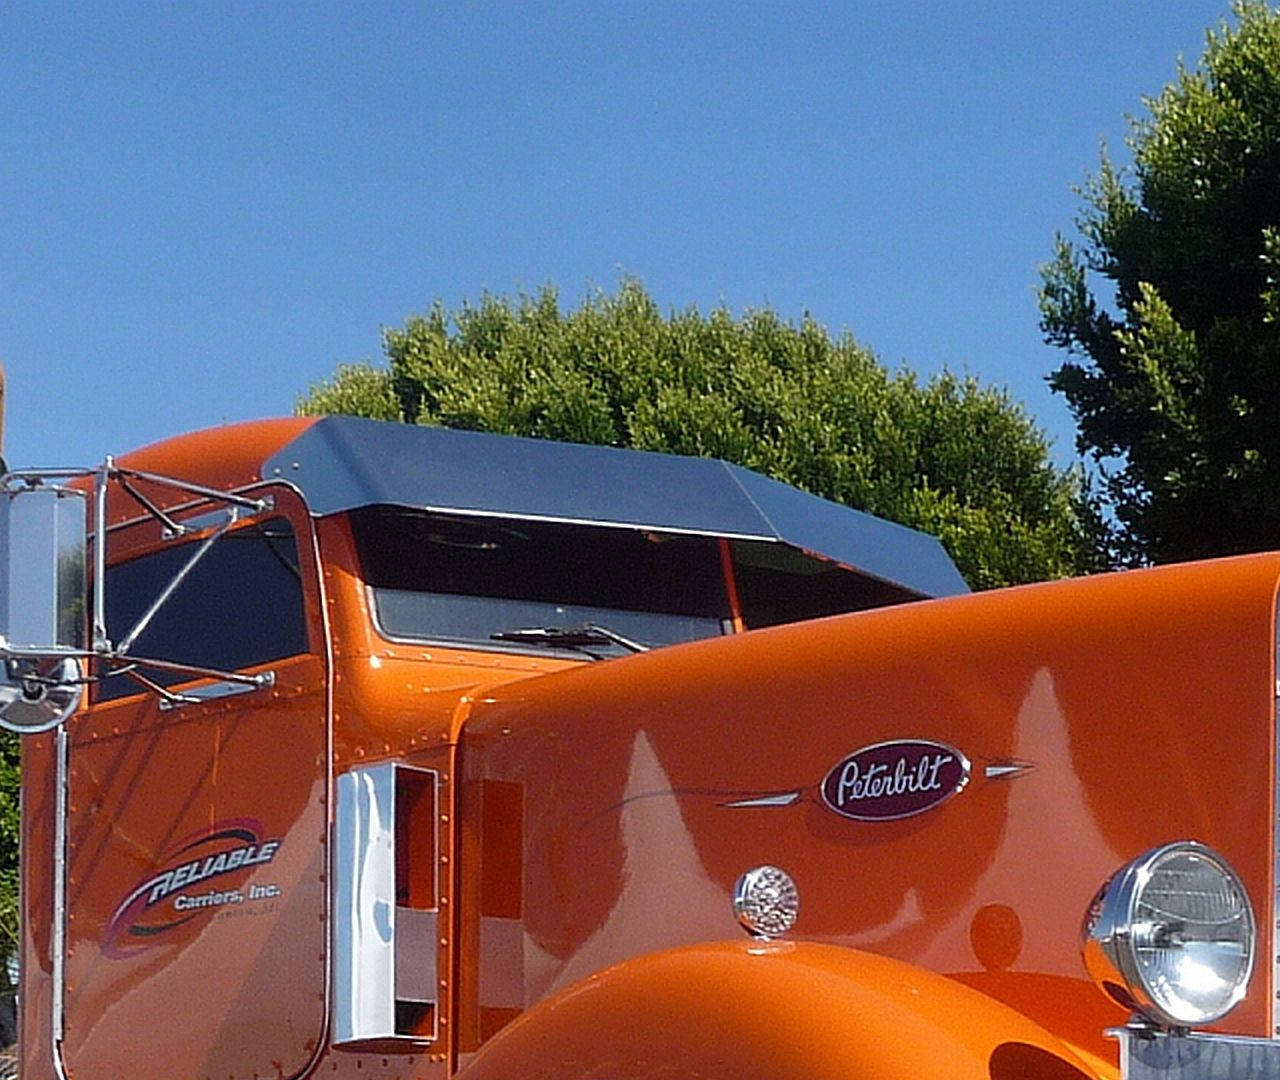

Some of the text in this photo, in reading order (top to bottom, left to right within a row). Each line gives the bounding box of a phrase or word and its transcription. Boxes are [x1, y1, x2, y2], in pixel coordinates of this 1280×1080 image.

[837, 755, 953, 806] Peterbilt
[147, 841, 280, 905] RELIABLE
[173, 889, 244, 911] Carriers,
[249, 884, 281, 900] Inc.
